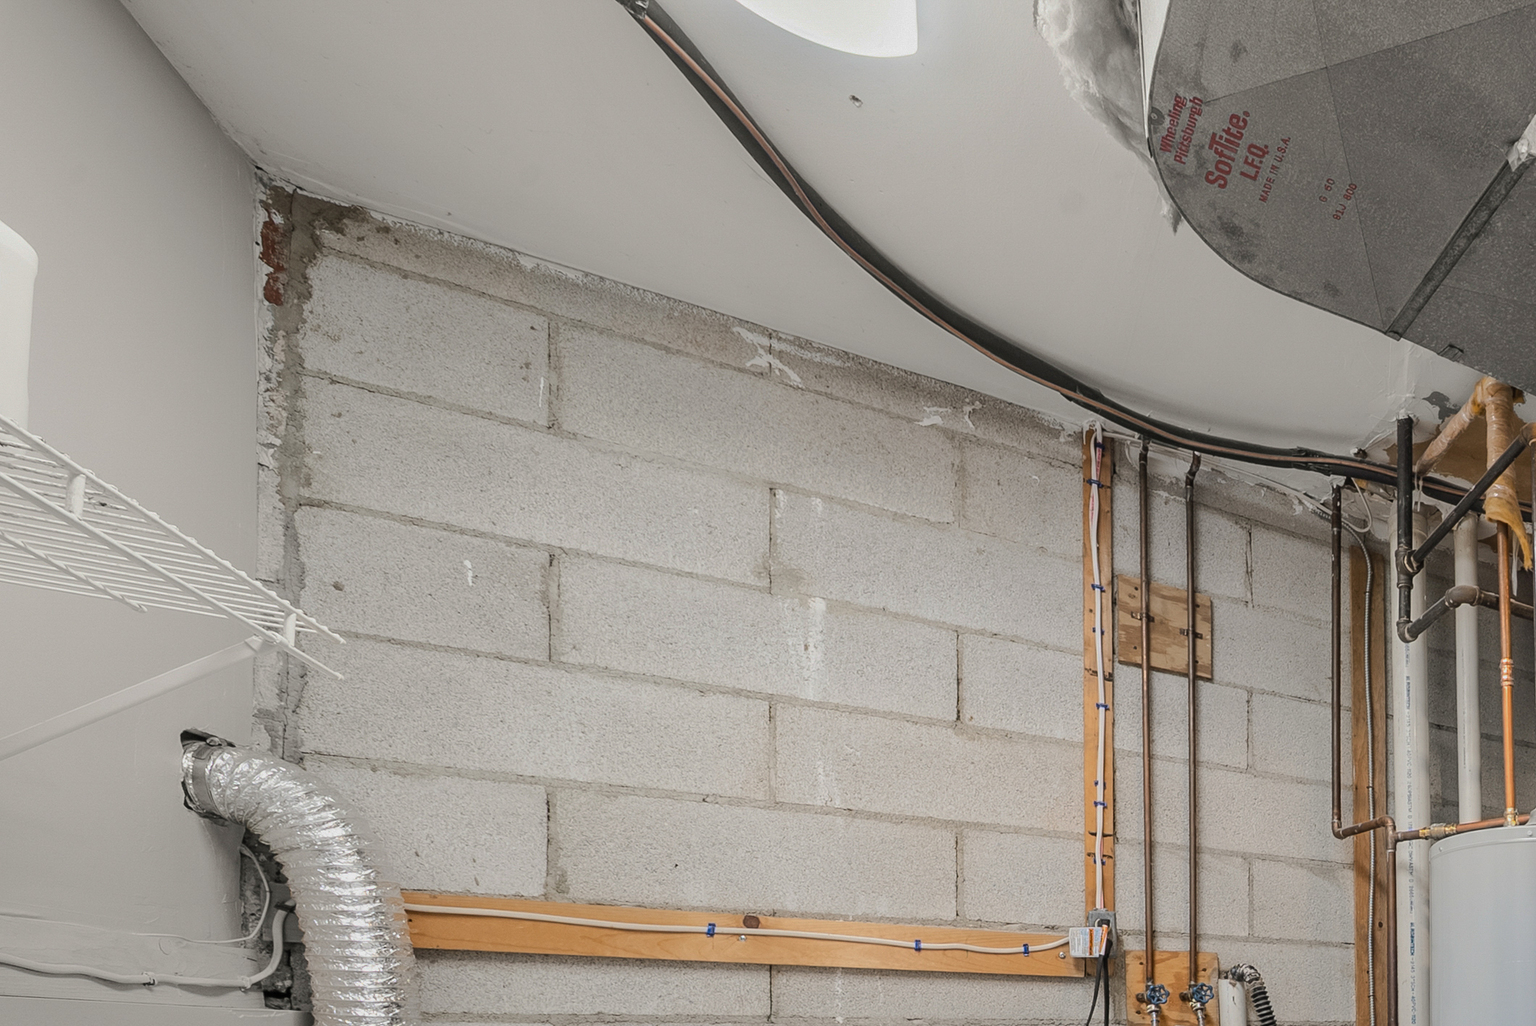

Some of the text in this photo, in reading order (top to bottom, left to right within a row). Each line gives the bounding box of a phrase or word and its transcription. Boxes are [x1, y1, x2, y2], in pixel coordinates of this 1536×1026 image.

[1159, 94, 1188, 154] Wheeling
[1173, 96, 1204, 165] Pittsburgh
[1259, 136, 1291, 203] MADE IN U.S.A.
